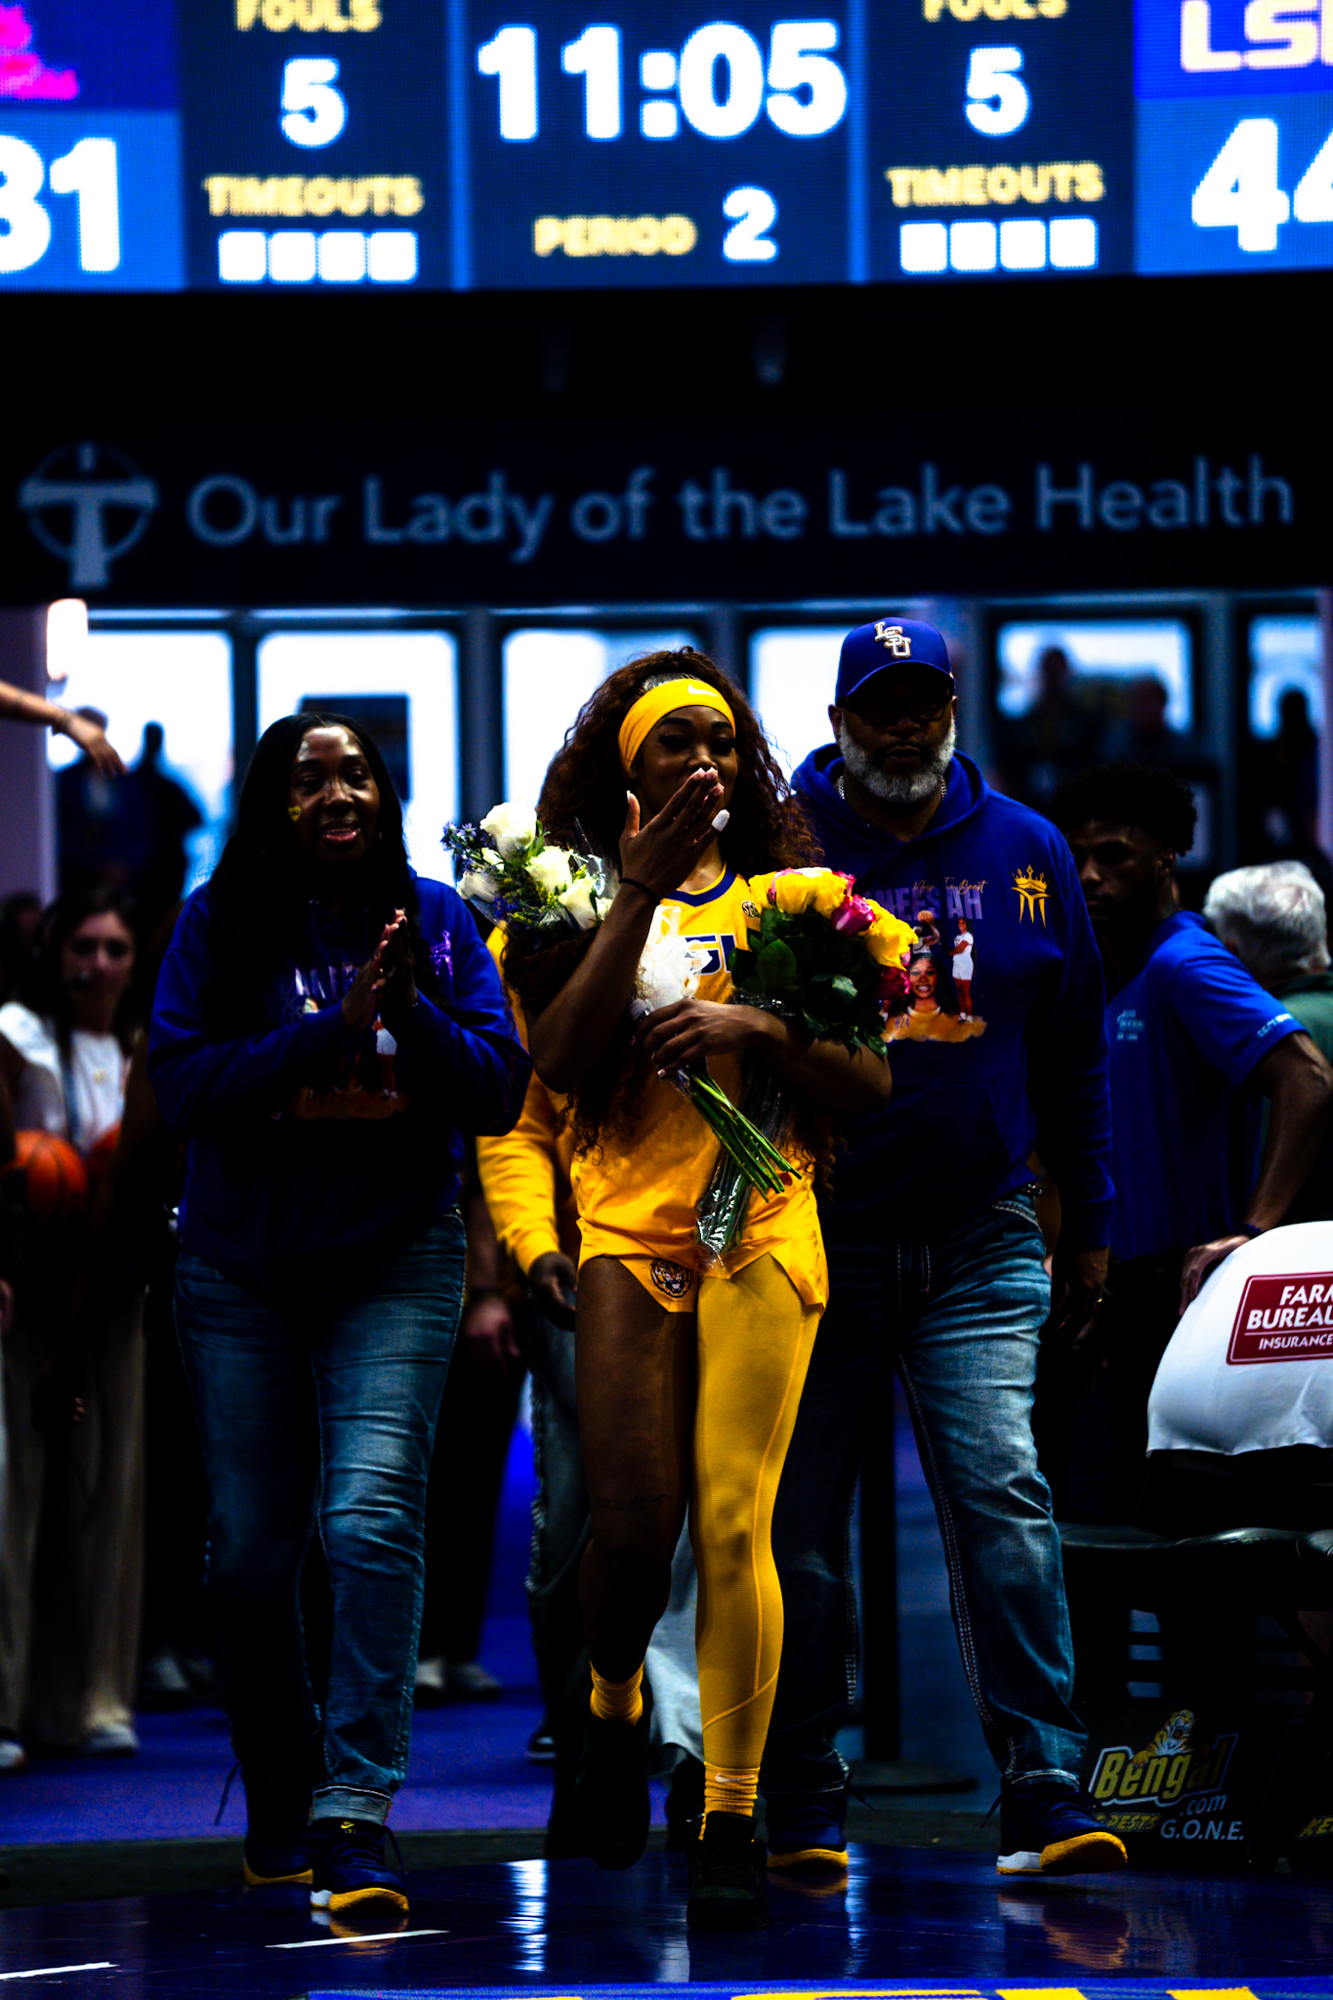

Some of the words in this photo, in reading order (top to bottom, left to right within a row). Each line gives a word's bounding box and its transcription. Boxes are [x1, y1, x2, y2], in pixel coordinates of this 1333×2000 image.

[235, 0, 382, 32] FOULS
[1181, 0, 1333, 72] LS
[281, 57, 348, 148] 5
[476, 20, 848, 141] 11:05
[965, 46, 1030, 135] 5
[205, 175, 424, 216] TIMEOUTS
[886, 161, 1105, 207] TIMEOUTS
[534, 214, 698, 257] PERIOD
[722, 186, 777, 262] 2
[187, 474, 338, 544] Our
[364, 469, 552, 563] Lady
[571, 466, 654, 541] of
[679, 466, 806, 540] the
[829, 462, 1010, 535] Lake
[1036, 454, 1293, 531] Health
[874, 621, 912, 658] LSU
[861, 886, 983, 921] NEESAH
[1258, 1333, 1333, 1350] INSURANCE
[1093, 1739, 1231, 1800] Bengal
[1160, 1818, 1245, 1840] G.O.N.E.
[1298, 1816, 1333, 1838] KE
